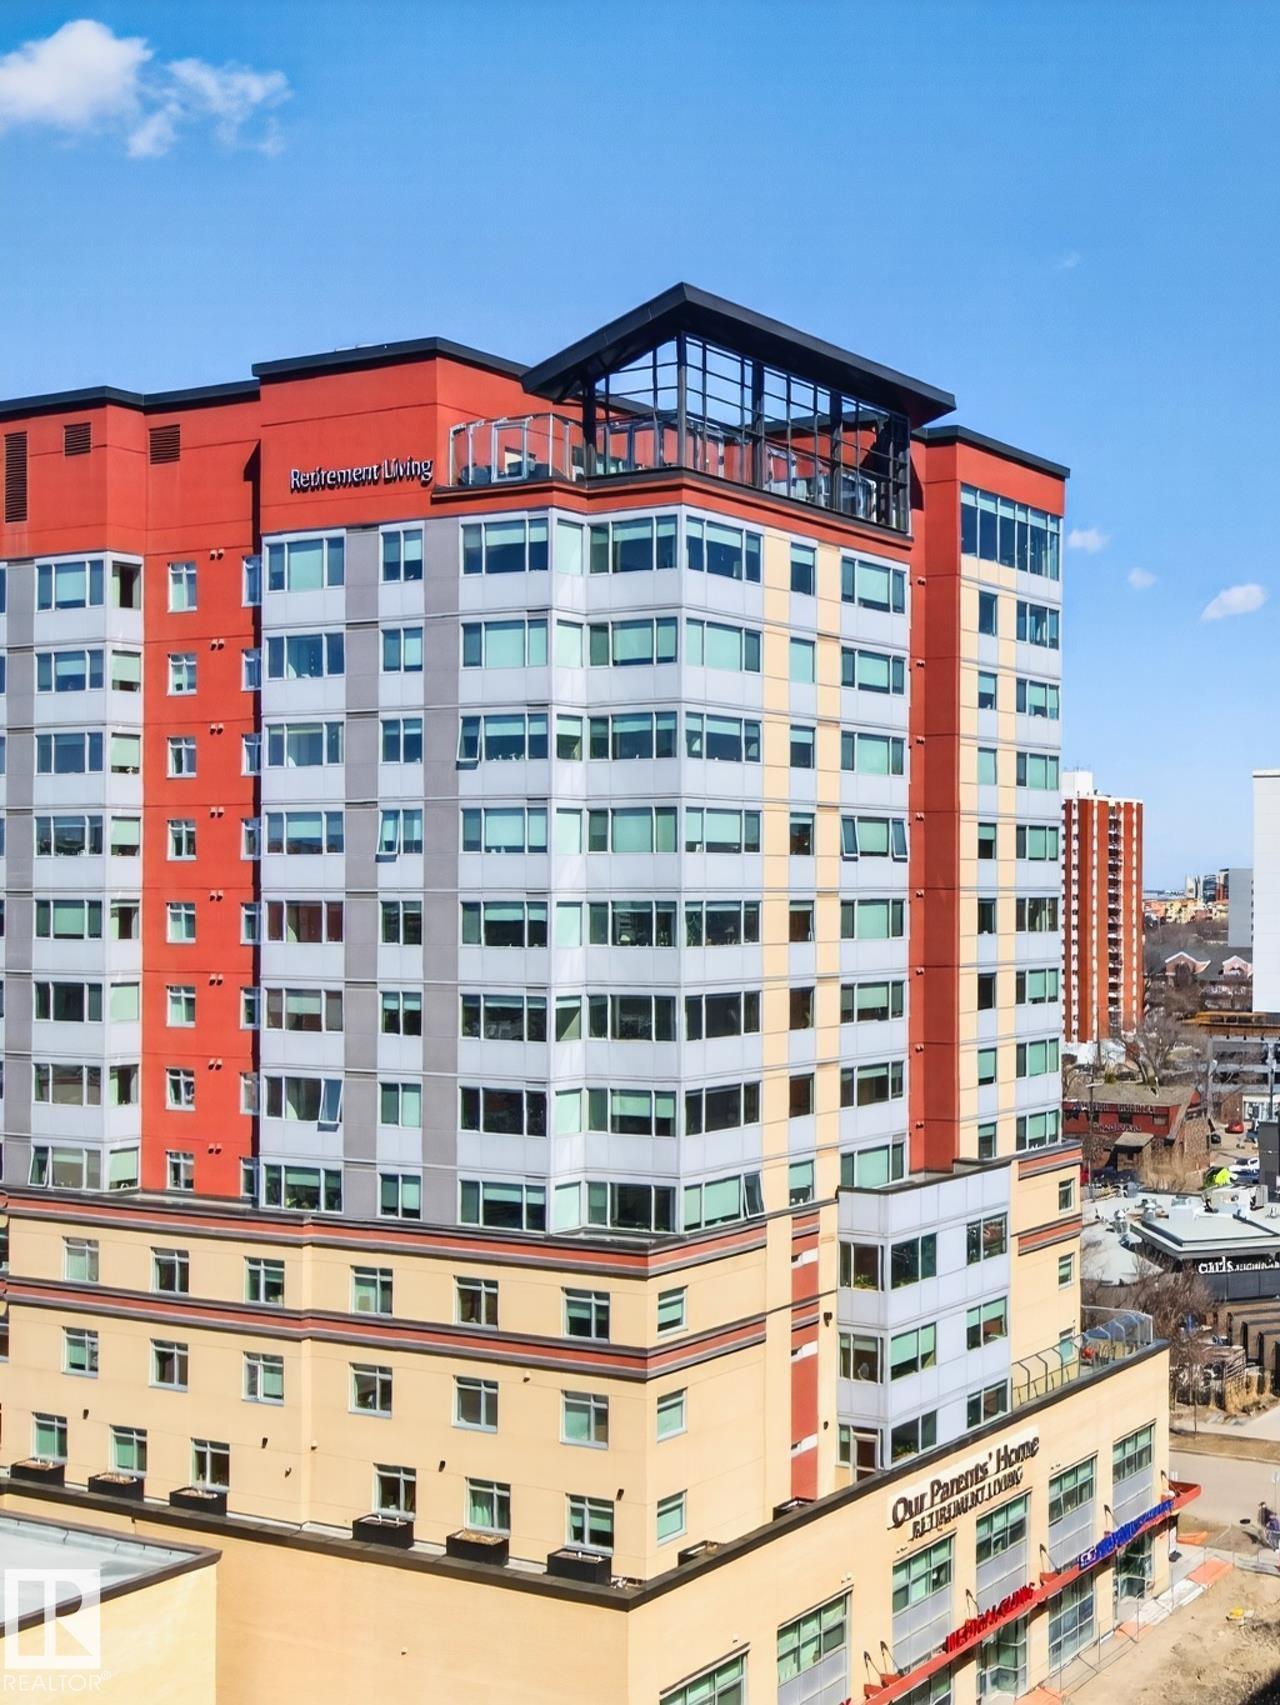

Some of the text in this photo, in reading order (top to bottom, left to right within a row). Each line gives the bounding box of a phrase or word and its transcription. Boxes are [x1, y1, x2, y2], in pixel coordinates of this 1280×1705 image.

[291, 457, 433, 489] Retirement Living
[887, 1492, 928, 1531] Our
[995, 1437, 1040, 1475] Home
